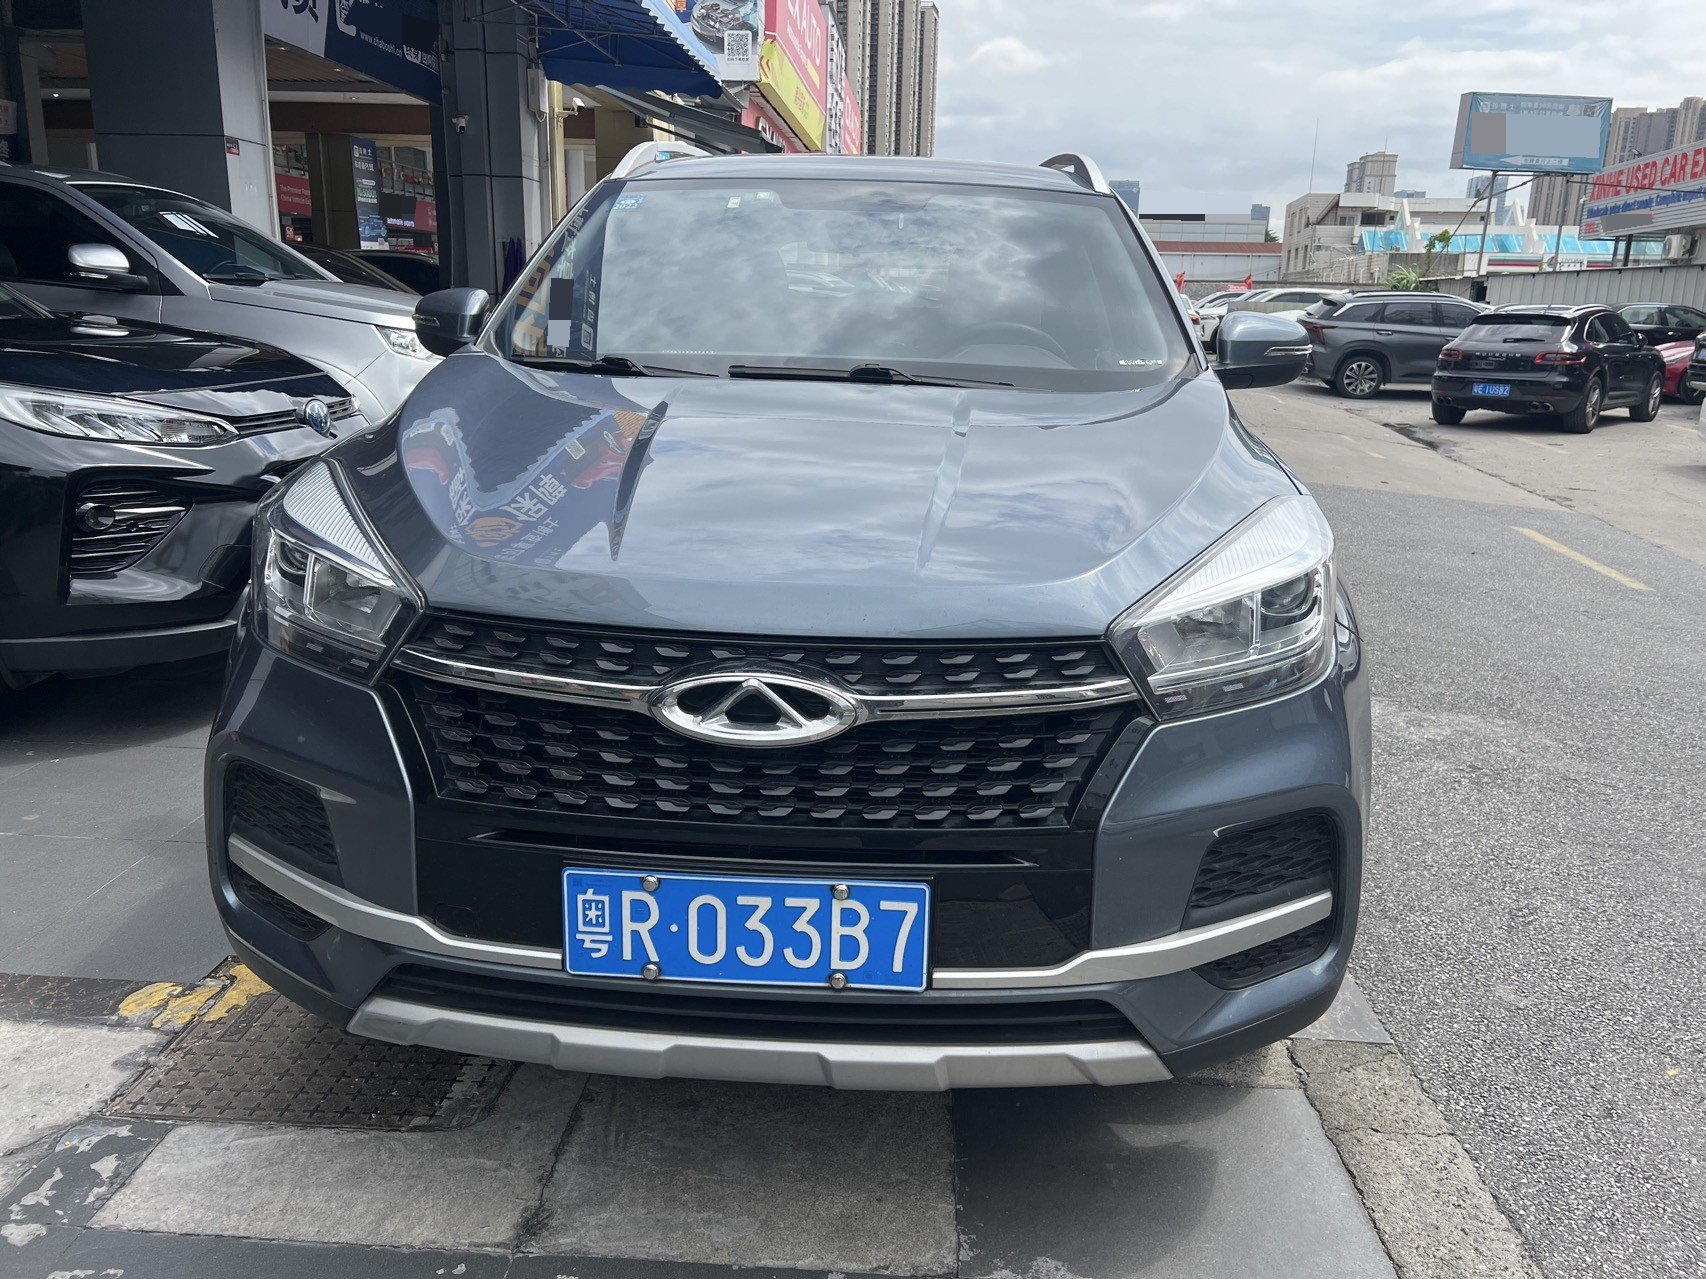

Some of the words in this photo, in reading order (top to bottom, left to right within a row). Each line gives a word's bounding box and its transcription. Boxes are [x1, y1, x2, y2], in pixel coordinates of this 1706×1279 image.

[1589, 169, 1625, 202] XINHE
[1625, 160, 1658, 194] USED
[1659, 151, 1688, 187] CAR
[576, 888, 918, 974] 粤R·033B7
